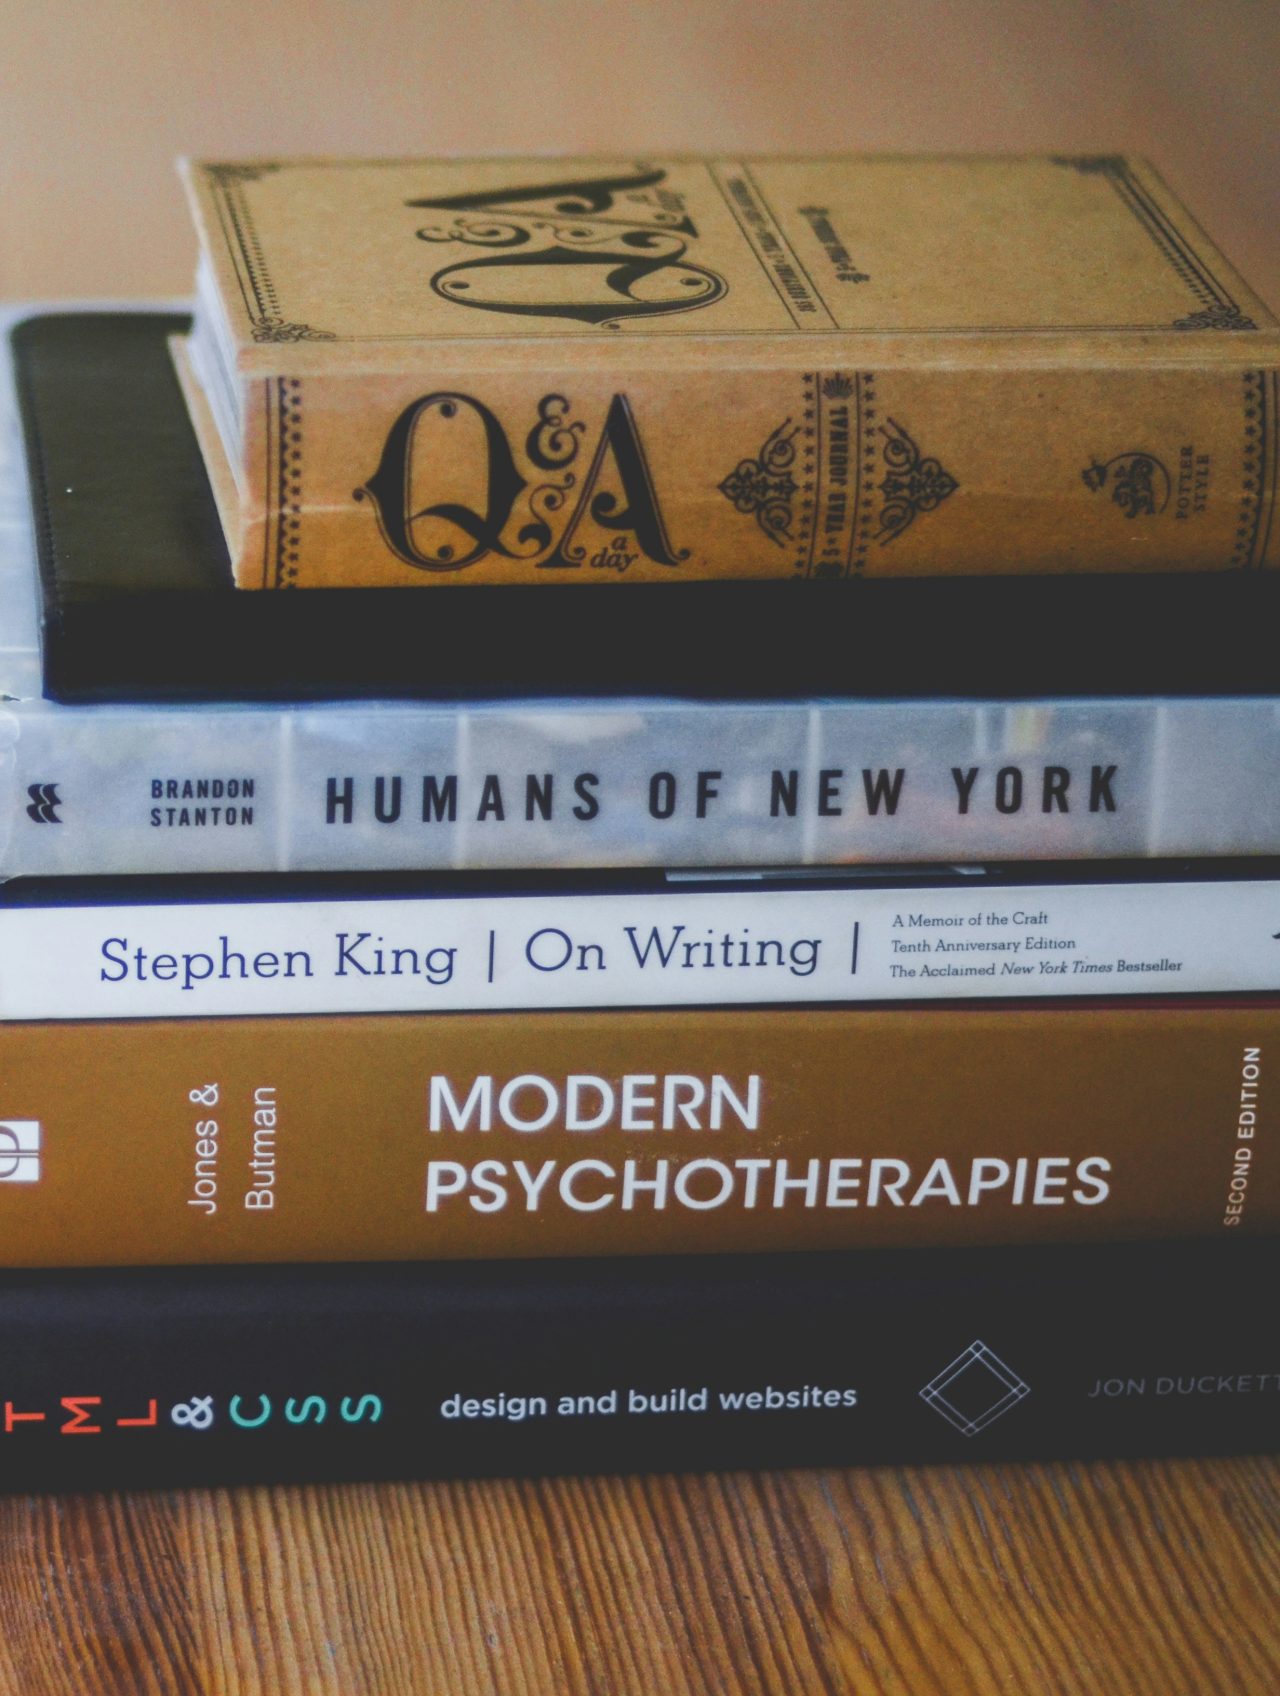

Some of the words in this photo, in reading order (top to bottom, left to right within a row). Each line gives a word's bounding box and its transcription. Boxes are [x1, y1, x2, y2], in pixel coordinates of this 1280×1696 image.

[829, 406, 849, 486] JOURNAL
[352, 391, 690, 572] Q&A
[590, 550, 638, 572] day
[151, 779, 255, 799] BRANDON
[325, 772, 600, 824] HUMANS
[648, 770, 724, 820] OF
[769, 768, 905, 818] NEW
[951, 764, 1118, 816] YORK
[150, 807, 254, 827] STANTON
[892, 914, 905, 928] A
[908, 913, 964, 927] Memoir
[968, 911, 983, 926] of
[986, 912, 1009, 926] the
[1012, 911, 1048, 925] Craft
[100, 936, 314, 990] Stephen
[334, 932, 458, 985] King
[525, 927, 606, 973] On
[623, 925, 822, 977] Writing
[891, 939, 932, 953] Tenth
[935, 938, 1021, 953] Anniversary
[1025, 936, 1076, 951] Edition
[889, 964, 916, 978] The
[919, 962, 996, 978] Acclaimed
[1000, 962, 1035, 976] New
[1039, 961, 1068, 975] York
[1072, 960, 1113, 974] Times
[1116, 958, 1183, 974] Bestseller
[189, 1082, 219, 1106] &
[428, 1074, 761, 1133] MODERN
[245, 1087, 277, 1210] Butman
[1224, 1147, 1252, 1227] SECOND
[1238, 1047, 1261, 1139] EDITION
[188, 1119, 218, 1215] Jones
[425, 1157, 1112, 1213] PSYCHOTHERAPIES
[440, 1394, 548, 1421] design
[556, 1390, 617, 1416] and
[627, 1388, 708, 1415] build
[719, 1385, 858, 1411] websites
[1088, 1377, 1146, 1398] JON
[171, 1395, 214, 1430] &
